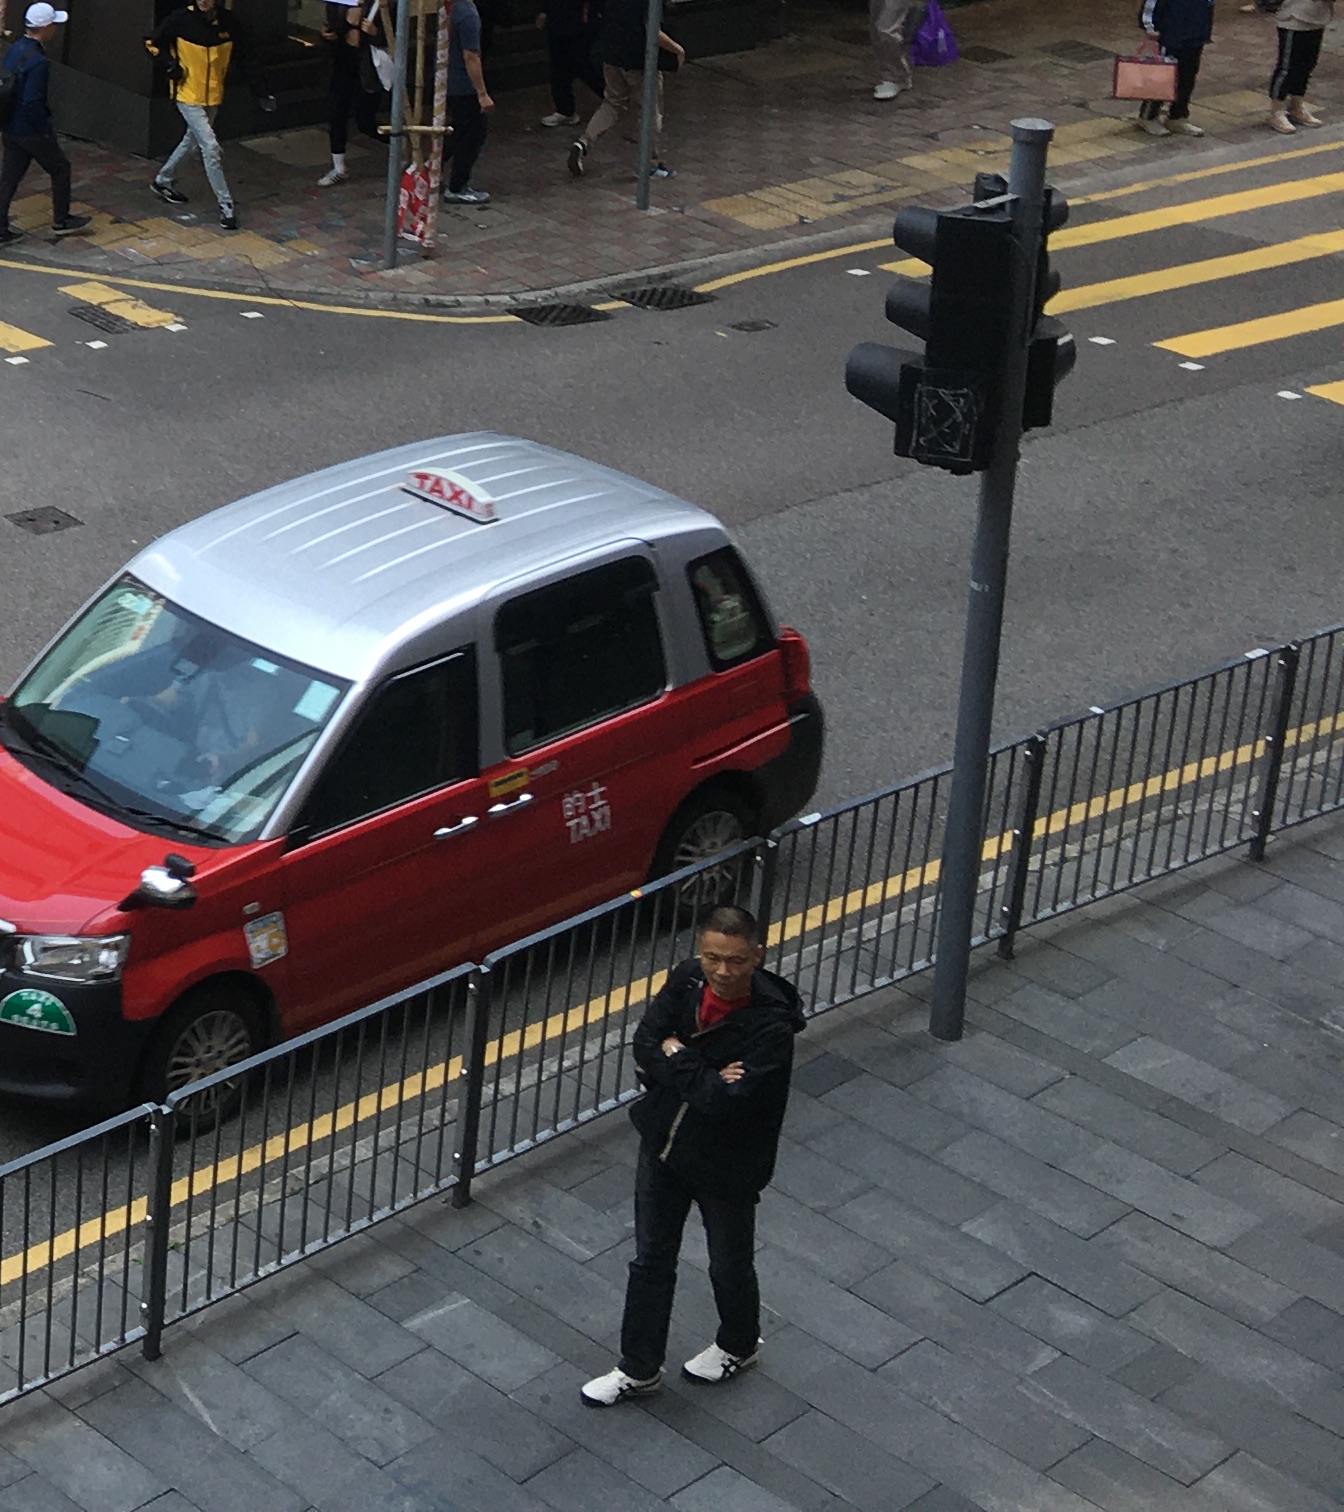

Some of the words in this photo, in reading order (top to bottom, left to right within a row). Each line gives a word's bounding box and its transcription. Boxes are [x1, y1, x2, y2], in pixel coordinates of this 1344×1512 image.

[414, 473, 474, 511] TAXI
[562, 781, 609, 819] 的士
[565, 805, 612, 844] TAXI
[24, 1002, 44, 1019] 4
